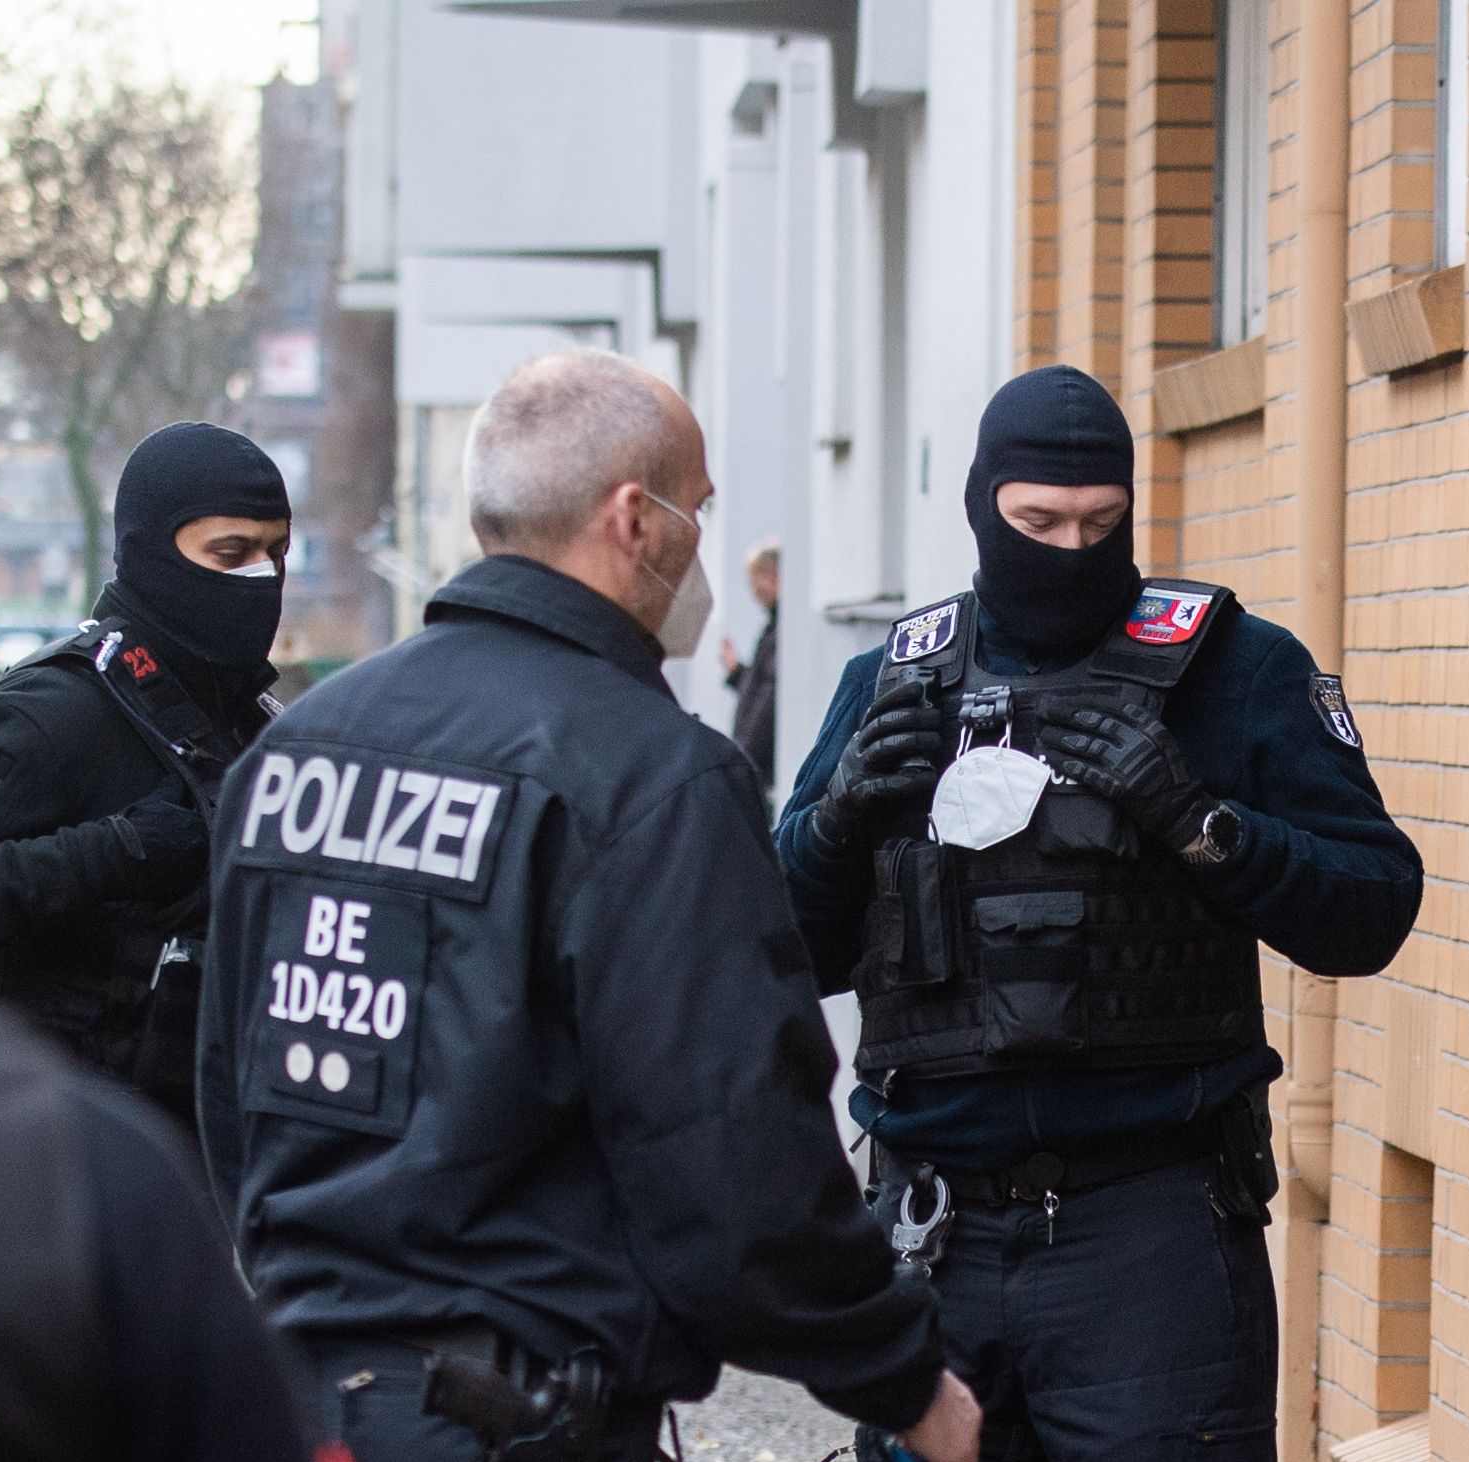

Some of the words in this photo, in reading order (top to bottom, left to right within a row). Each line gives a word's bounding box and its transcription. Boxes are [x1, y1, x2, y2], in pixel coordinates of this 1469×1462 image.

[900, 606, 952, 633] POLIZEI
[124, 647, 158, 677] 23
[242, 754, 501, 882] POLIZEI
[305, 896, 371, 963] BE
[268, 961, 407, 1040] 1D420
